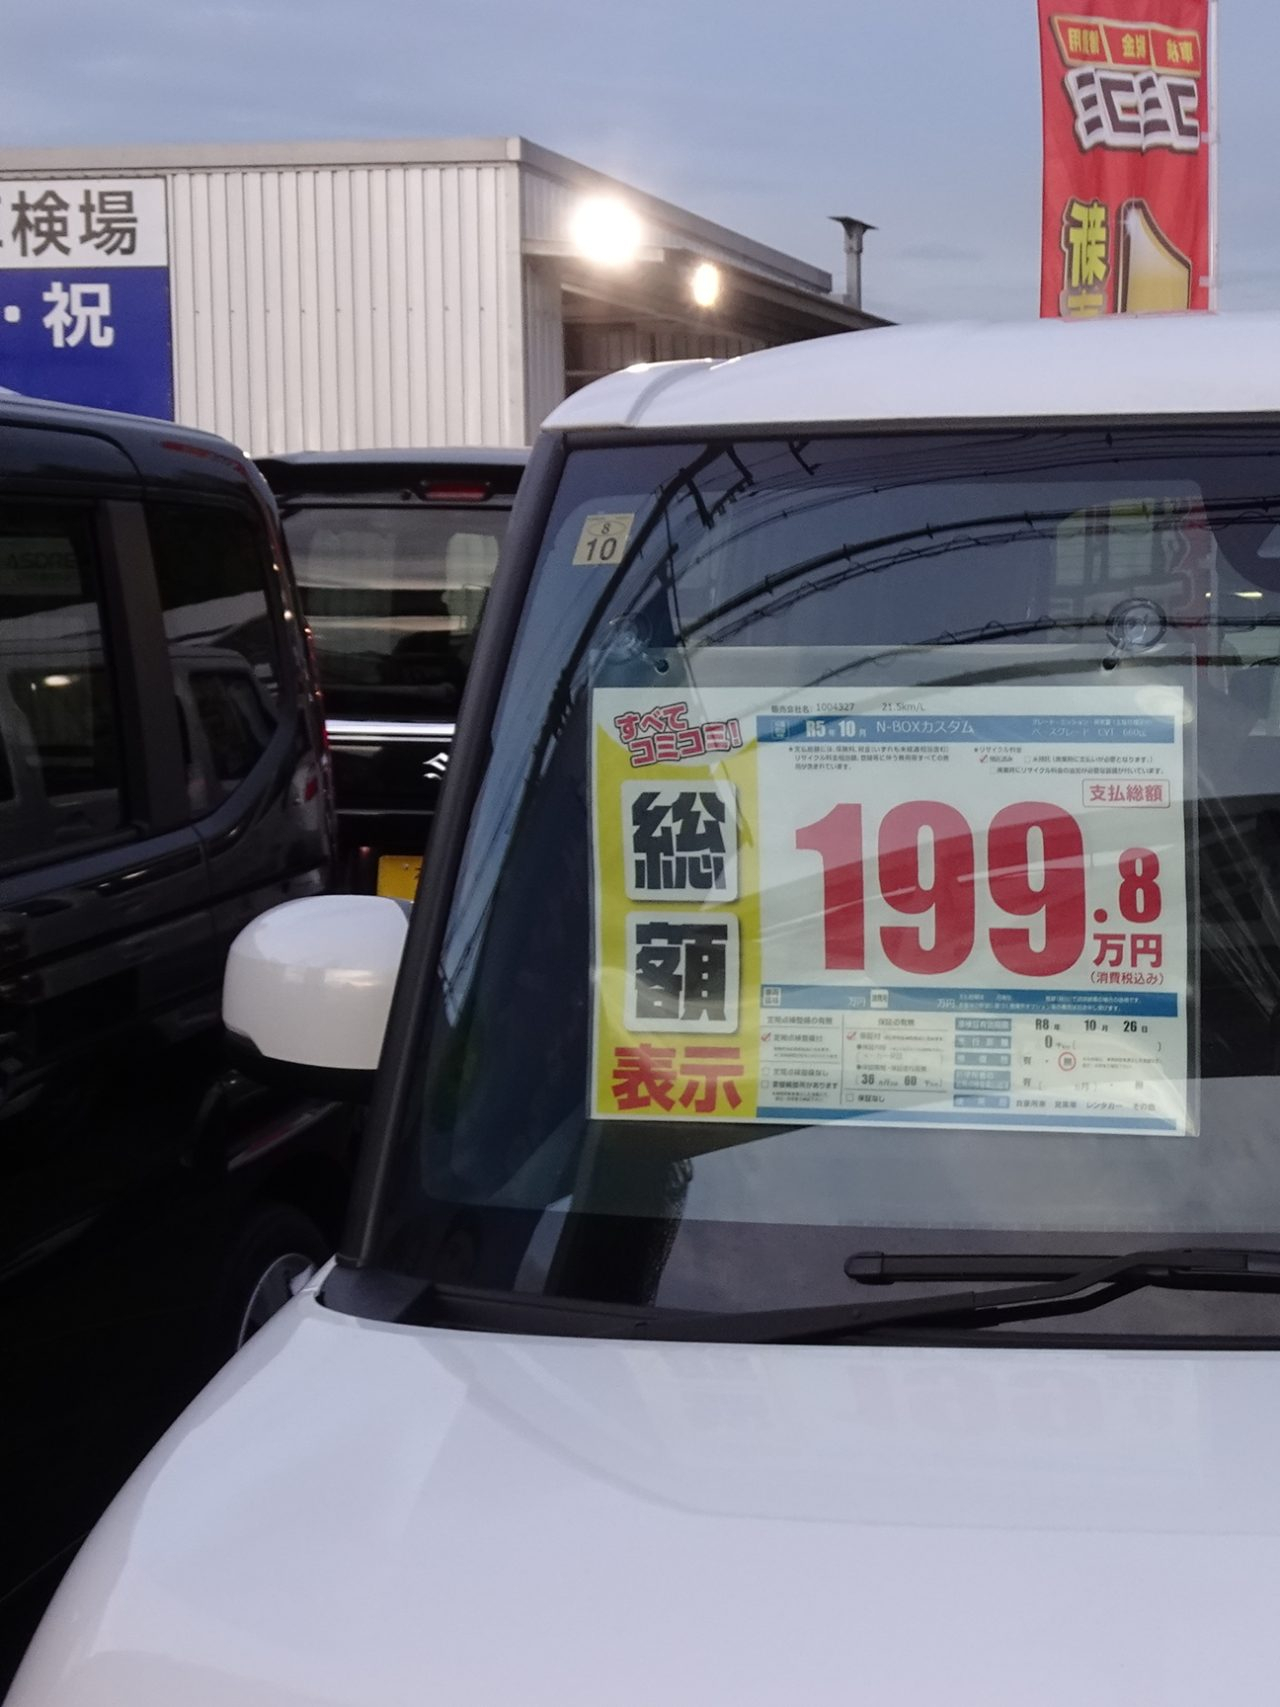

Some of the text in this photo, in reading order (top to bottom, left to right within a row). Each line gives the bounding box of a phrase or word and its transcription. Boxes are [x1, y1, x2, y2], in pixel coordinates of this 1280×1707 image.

[0, 189, 138, 257] 検場
[586, 537, 617, 561] 10
[616, 703, 687, 743] すべて
[876, 720, 975, 734] N-BOXカスタム
[1089, 784, 1163, 803] 支払総額
[796, 801, 1162, 977] 199.8
[1092, 933, 1163, 967] 万円
[1090, 970, 1164, 985] (消費税込み)
[611, 1043, 744, 1113] 表示
